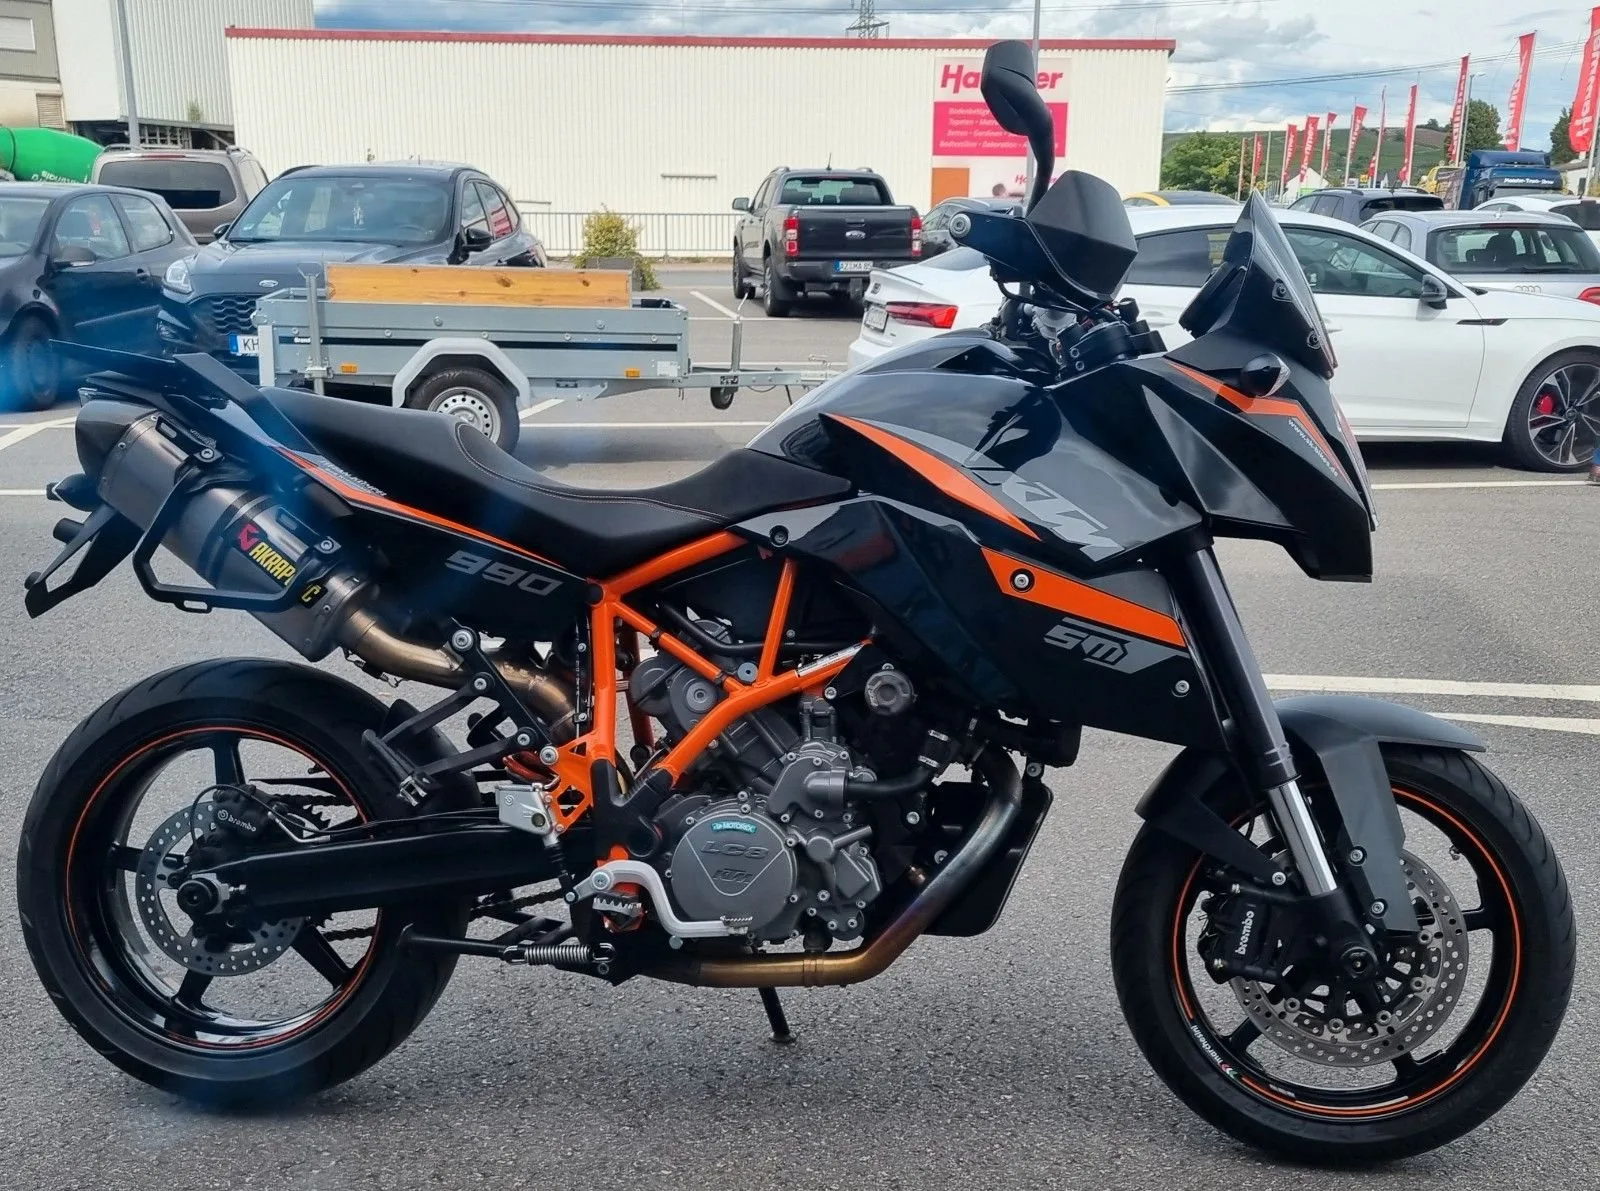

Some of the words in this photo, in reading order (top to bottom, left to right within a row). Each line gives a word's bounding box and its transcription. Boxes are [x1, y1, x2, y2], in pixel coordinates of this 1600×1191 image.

[941, 64, 1063, 94] Haer
[1002, 471, 1125, 562] KTM
[444, 550, 564, 596] 990
[228, 814, 257, 832] brembo
[721, 821, 756, 833] MOTOREX
[700, 840, 769, 859] LC8
[1235, 910, 1255, 955] brembo
